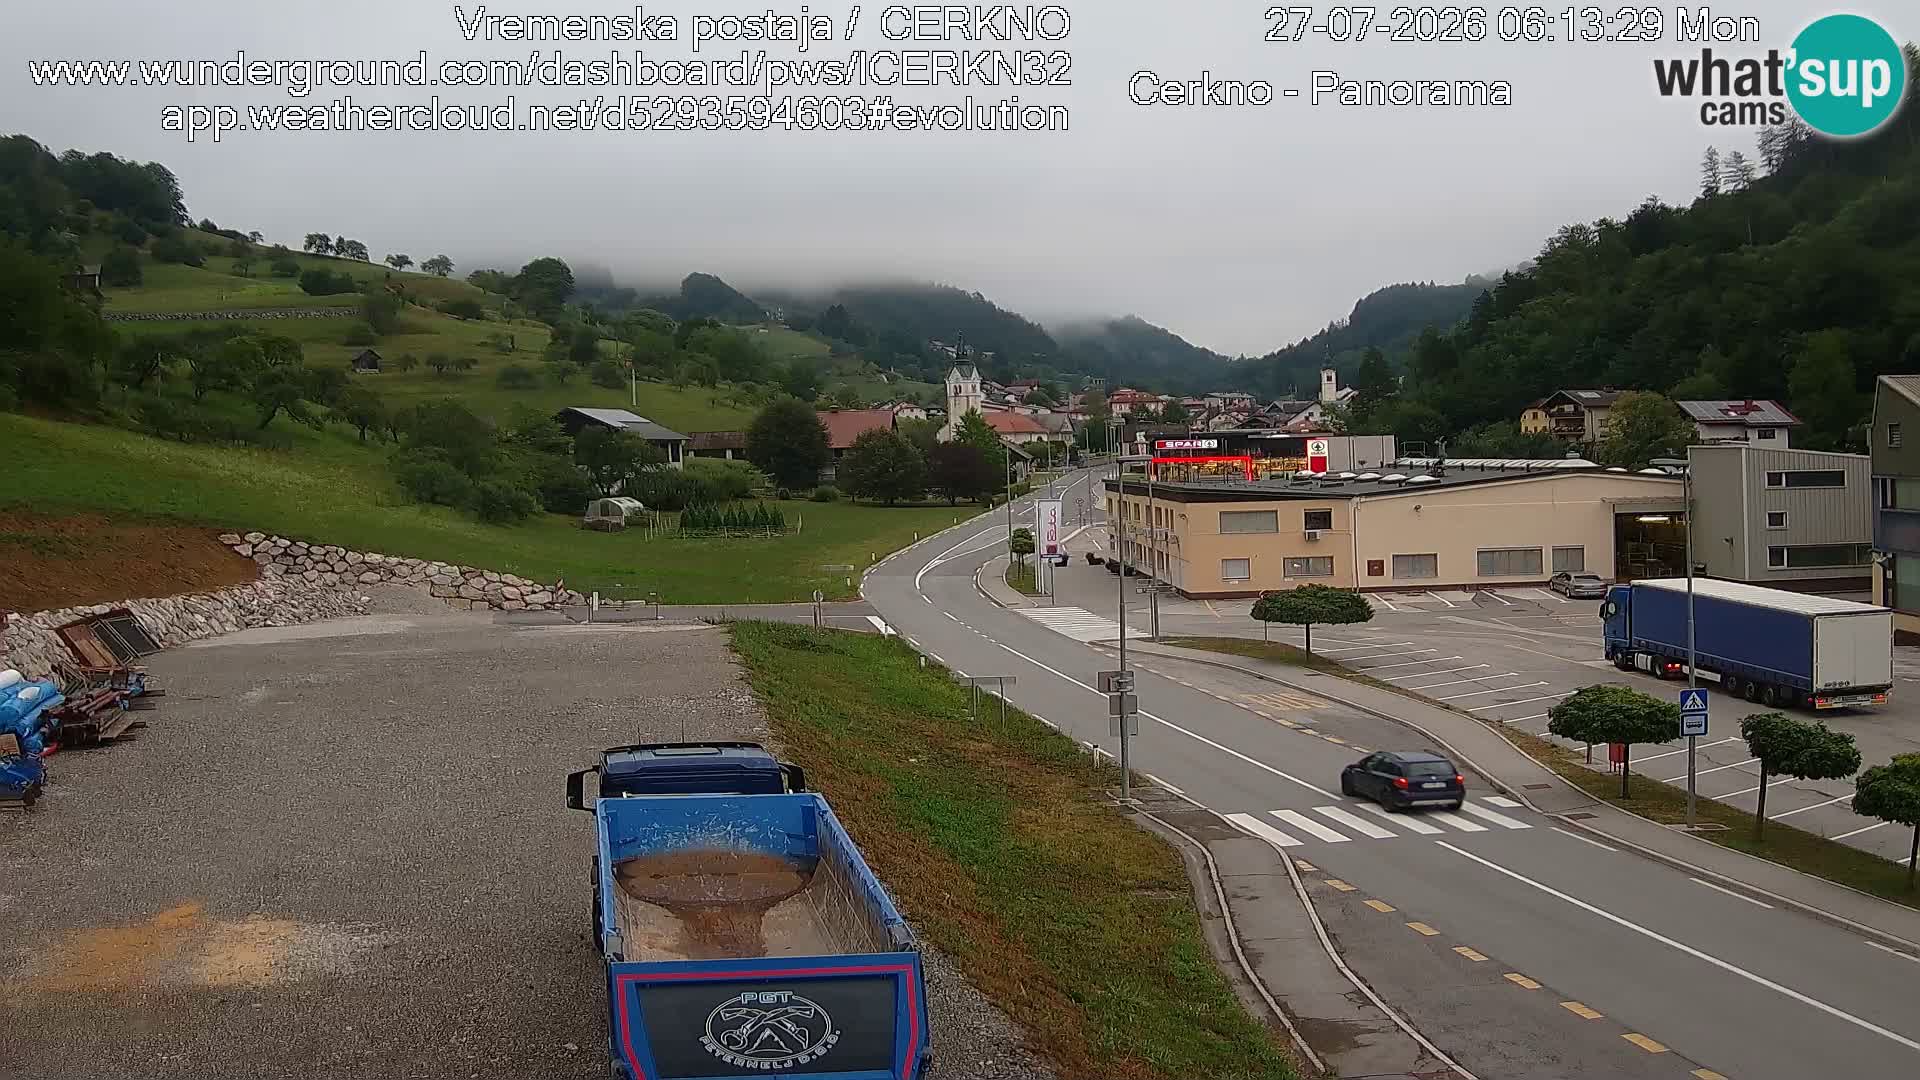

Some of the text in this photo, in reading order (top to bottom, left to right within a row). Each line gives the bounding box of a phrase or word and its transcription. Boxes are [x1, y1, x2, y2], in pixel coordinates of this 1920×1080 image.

[1165, 440, 1202, 449] SPAR
[740, 990, 794, 1004] PGT
[699, 1035, 793, 1069] PETERNELJ
